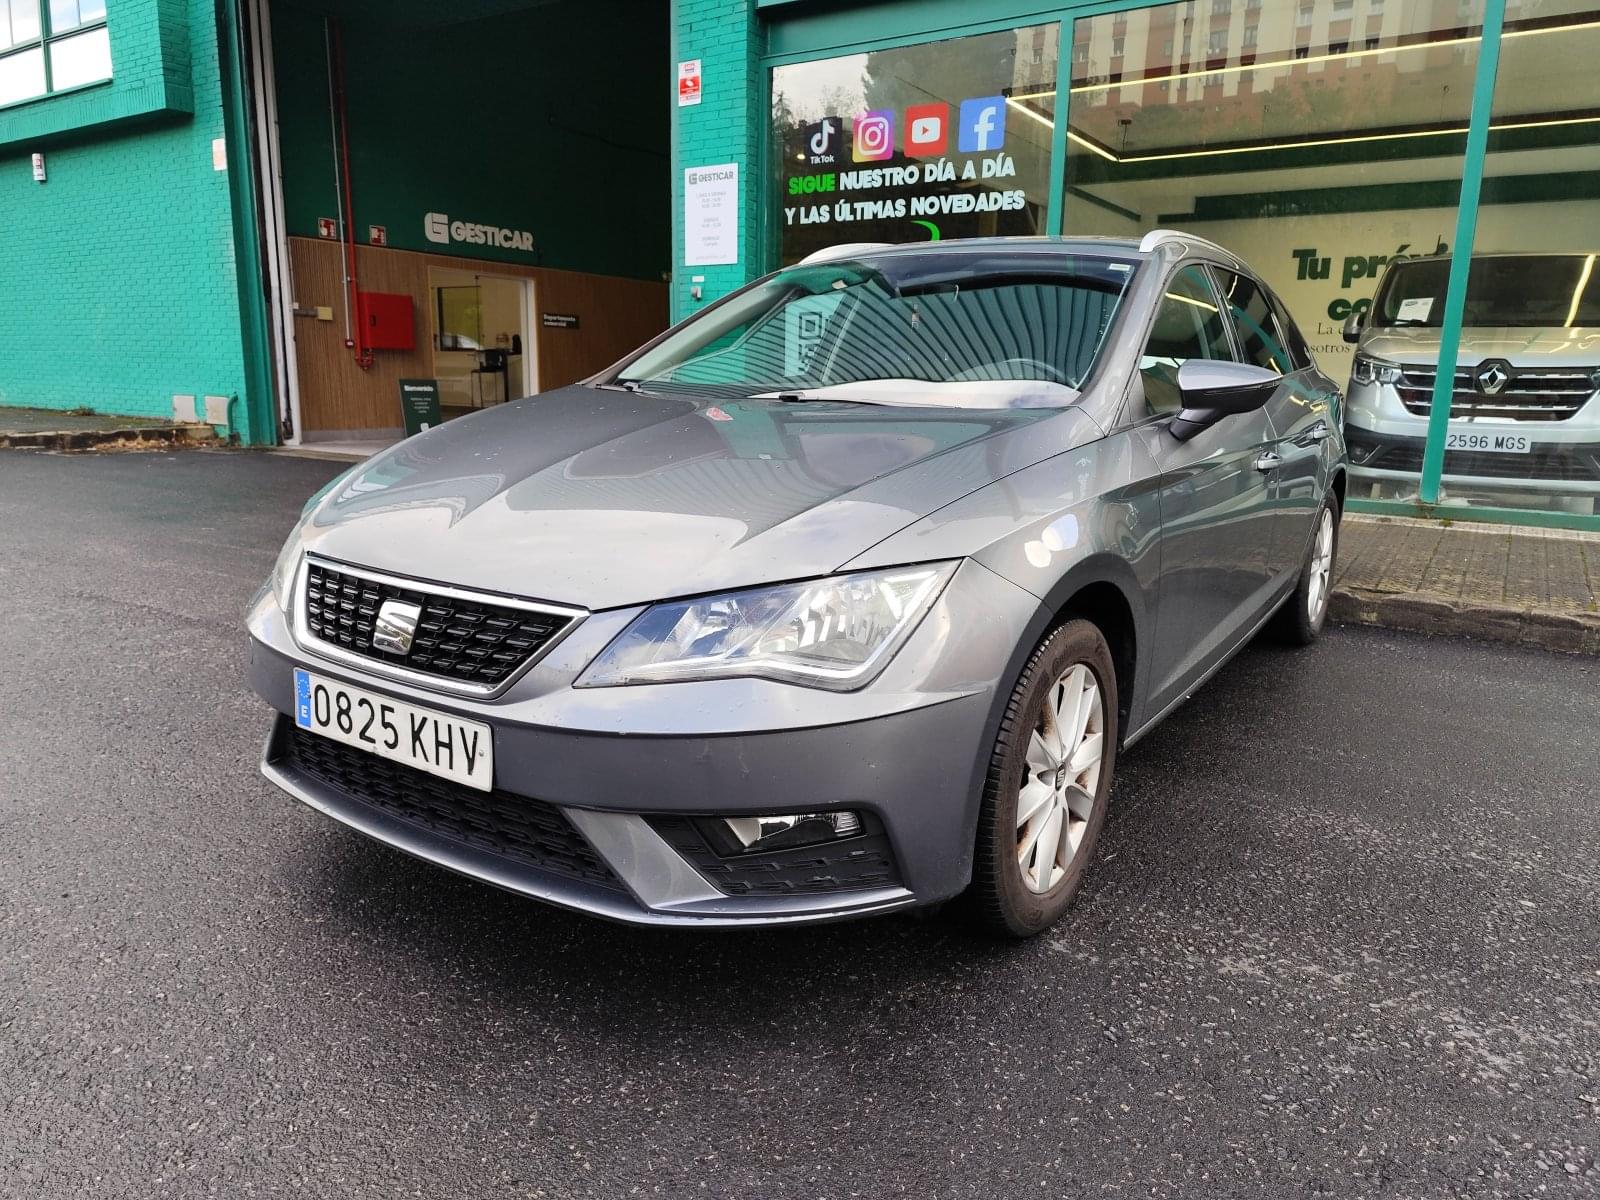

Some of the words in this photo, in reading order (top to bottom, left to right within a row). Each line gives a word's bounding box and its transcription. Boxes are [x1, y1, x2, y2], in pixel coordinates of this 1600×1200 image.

[810, 154, 834, 164] TikTok
[698, 171, 734, 183] GESTICAR
[788, 173, 836, 195] SIGUE
[839, 166, 920, 190] NUESTRO
[924, 157, 957, 183] DÍA
[961, 159, 977, 180] A
[982, 152, 1016, 178] DÍA
[784, 207, 797, 225] Y
[800, 205, 830, 225] LAS
[834, 199, 906, 222] ÚLTIMAS
[910, 190, 1026, 216] NOVEDADES
[450, 221, 534, 252] GESTICAR
[1292, 248, 1332, 281] Tu
[1317, 321, 1333, 335] La
[1447, 434, 1489, 449] 2596
[1494, 436, 1526, 450] MGS
[300, 706, 309, 719] E
[314, 684, 399, 750] 0825
[410, 712, 478, 776] KHV
